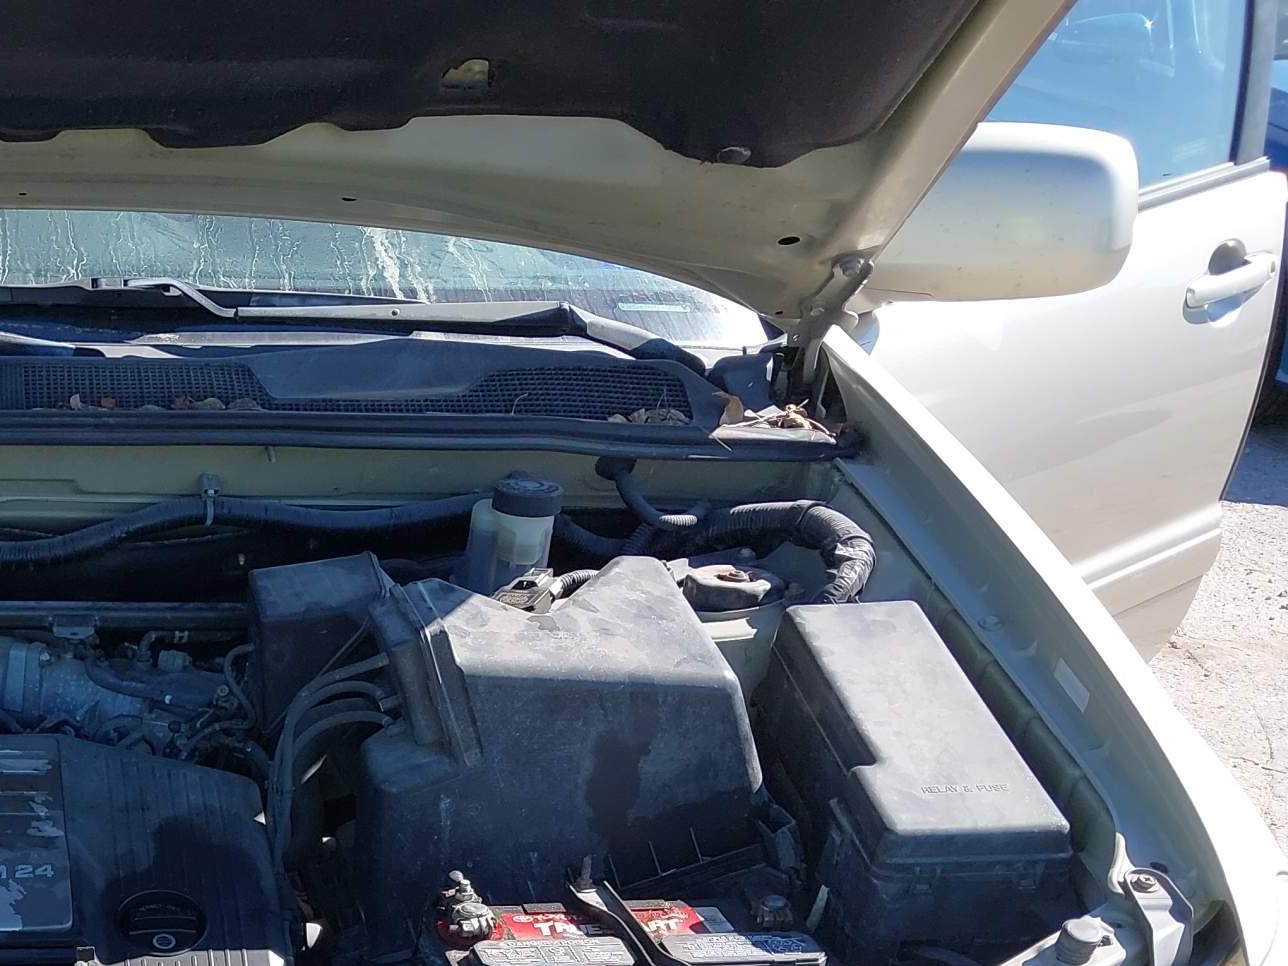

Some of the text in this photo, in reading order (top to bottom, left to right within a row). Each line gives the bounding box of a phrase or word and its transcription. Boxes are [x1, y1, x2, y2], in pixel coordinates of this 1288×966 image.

[920, 784, 1009, 794] RELAY & FUSE
[14, 863, 55, 879] 24
